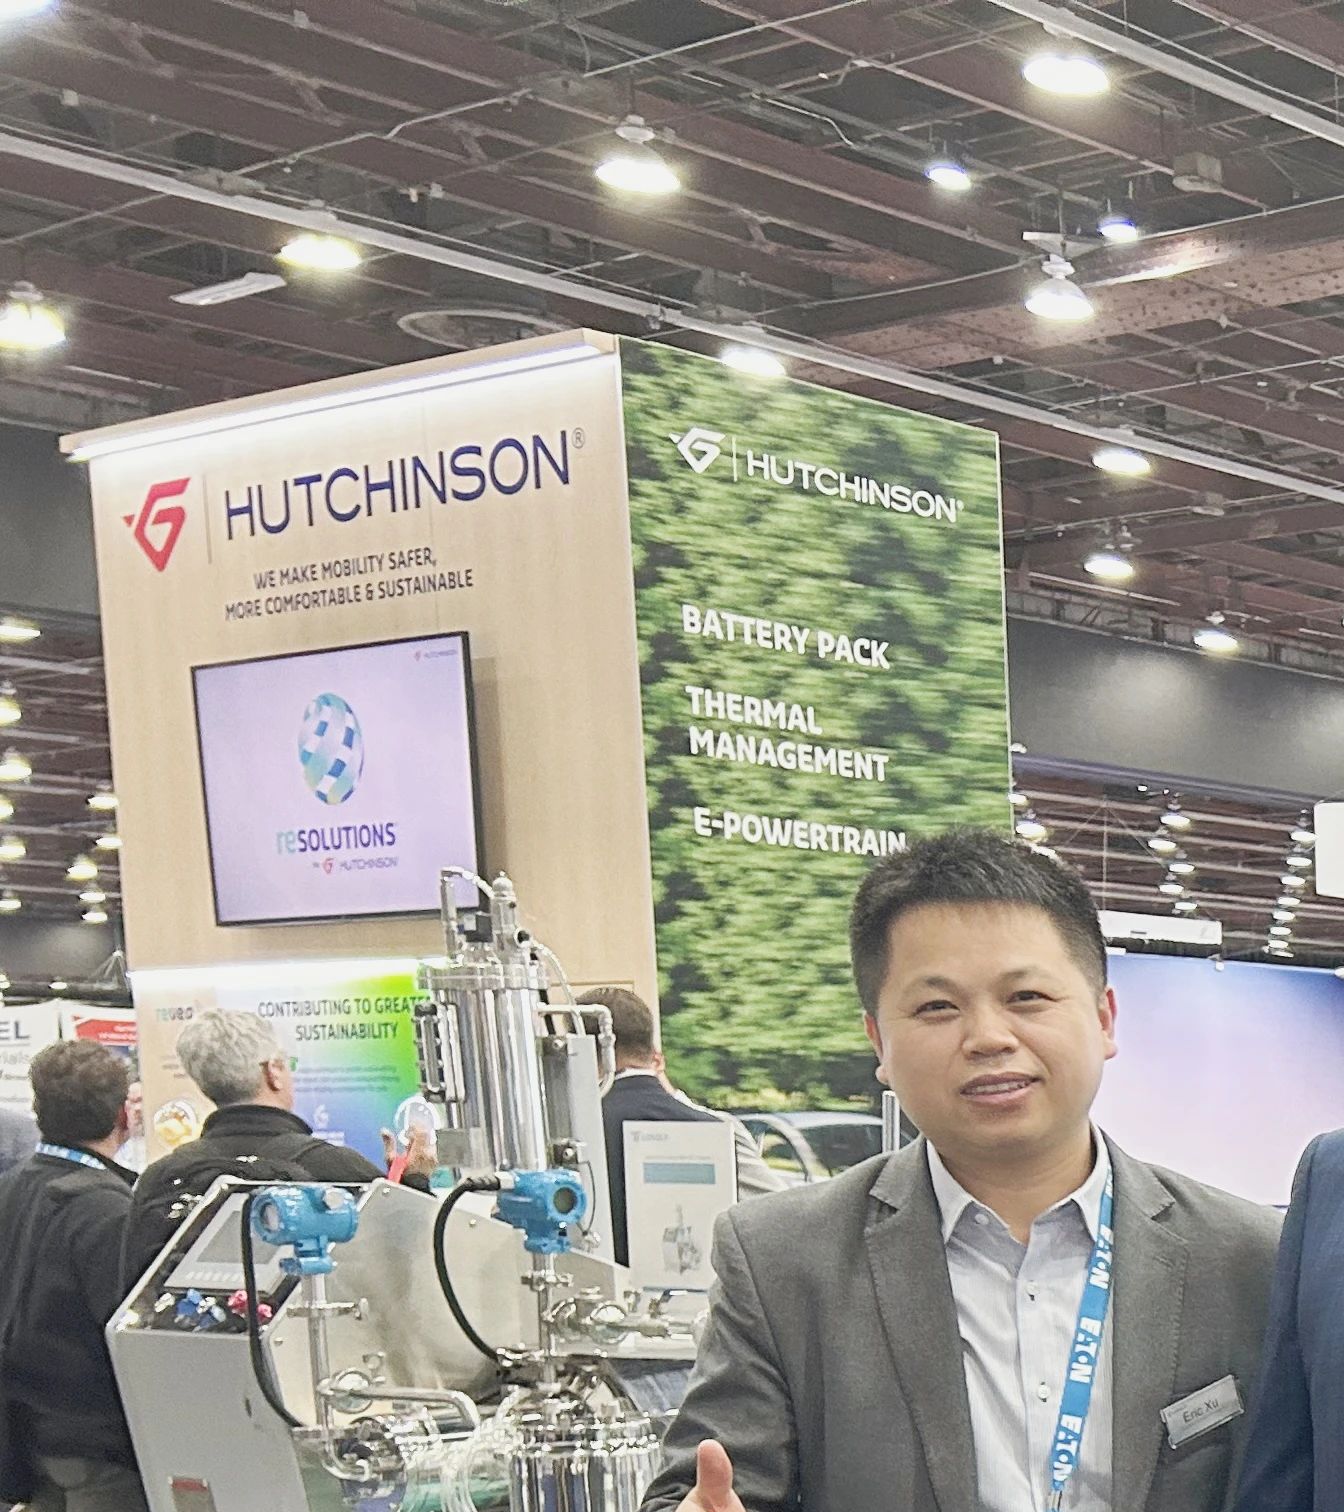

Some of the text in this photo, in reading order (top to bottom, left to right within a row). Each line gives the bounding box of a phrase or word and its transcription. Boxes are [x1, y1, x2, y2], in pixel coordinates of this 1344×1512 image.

[254, 547, 438, 590] WE MAKE MOBILITY SAFER,
[225, 568, 474, 621] MORE COMFORTABLE & SUSTAINABLE
[681, 604, 892, 669] BATTERY PACK
[685, 685, 823, 735] THERMAL
[688, 726, 890, 782] MANAGEMENT
[276, 823, 396, 855] reSOLUTIONS
[693, 806, 907, 857] E-POWERTRAIN
[258, 998, 371, 1018] CONTRIBUTING TO
[296, 1022, 399, 1042] SUSTAINABILITY
